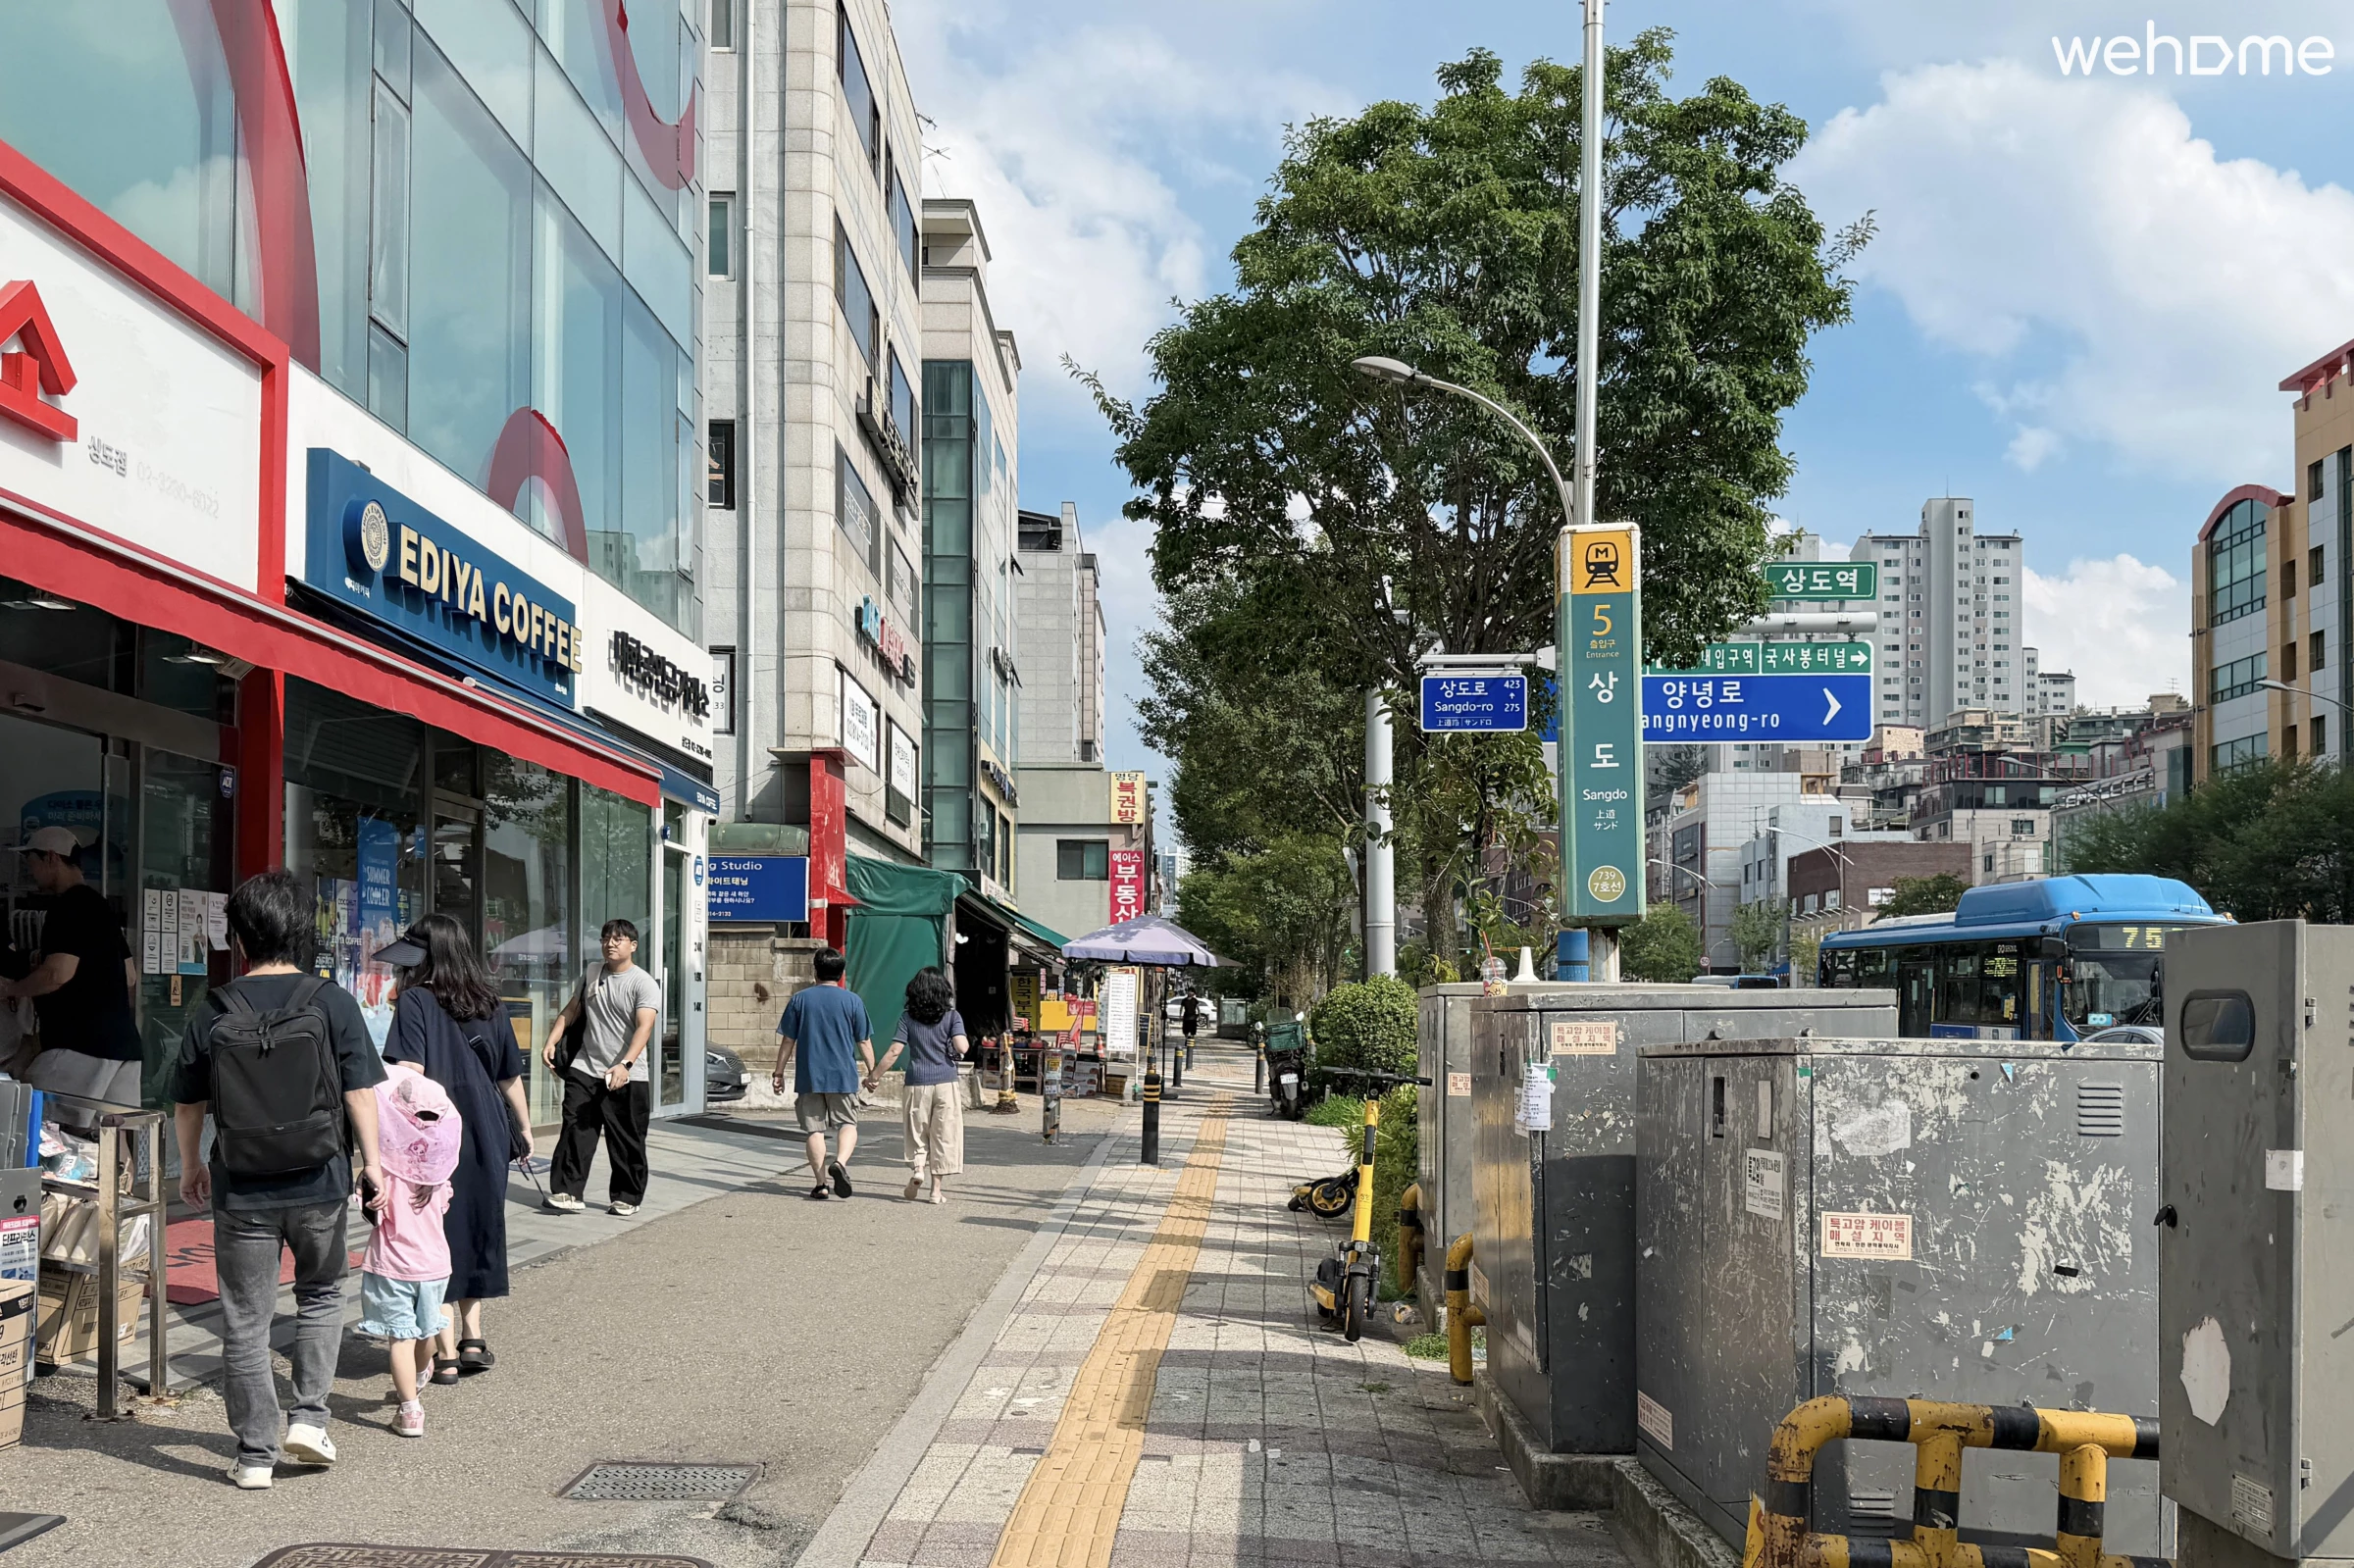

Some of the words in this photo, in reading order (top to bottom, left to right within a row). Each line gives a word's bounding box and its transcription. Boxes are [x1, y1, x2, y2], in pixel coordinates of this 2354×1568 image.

[1781, 568, 1859, 594] 상도역
[399, 524, 487, 624] EDIYA
[493, 582, 583, 675] COFFEE
[1592, 604, 1612, 636] 5
[1589, 639, 1616, 649] 출입구
[1586, 650, 1620, 659] Entrance
[1700, 648, 1754, 670] 대입구역
[1765, 647, 1846, 670] 국사봉터널
[1439, 680, 1489, 699] 상도로
[1504, 680, 1520, 689] 423
[1662, 681, 1745, 709] 양녕로
[1434, 701, 1494, 714] Sangdo-ro
[1504, 703, 1520, 712] 275
[1642, 713, 1781, 733] angnyeong-ro
[1582, 788, 1628, 802] Sangdo
[1116, 782, 1138, 823] 복권방
[1595, 809, 1616, 820] 上道
[1593, 821, 1618, 831] サンド
[1112, 852, 1142, 863] 에이스
[721, 861, 763, 871] Studio
[366, 865, 390, 885] SUMMER
[1598, 871, 1616, 880] 739
[1593, 882, 1621, 893] 7호선
[2122, 927, 2165, 949] 75
[1557, 1026, 1582, 1036] 특고압
[1829, 1218, 1866, 1231] 특고압
[1869, 1219, 1906, 1232] 케이블
[2, 1230, 36, 1247] 단프라박스
